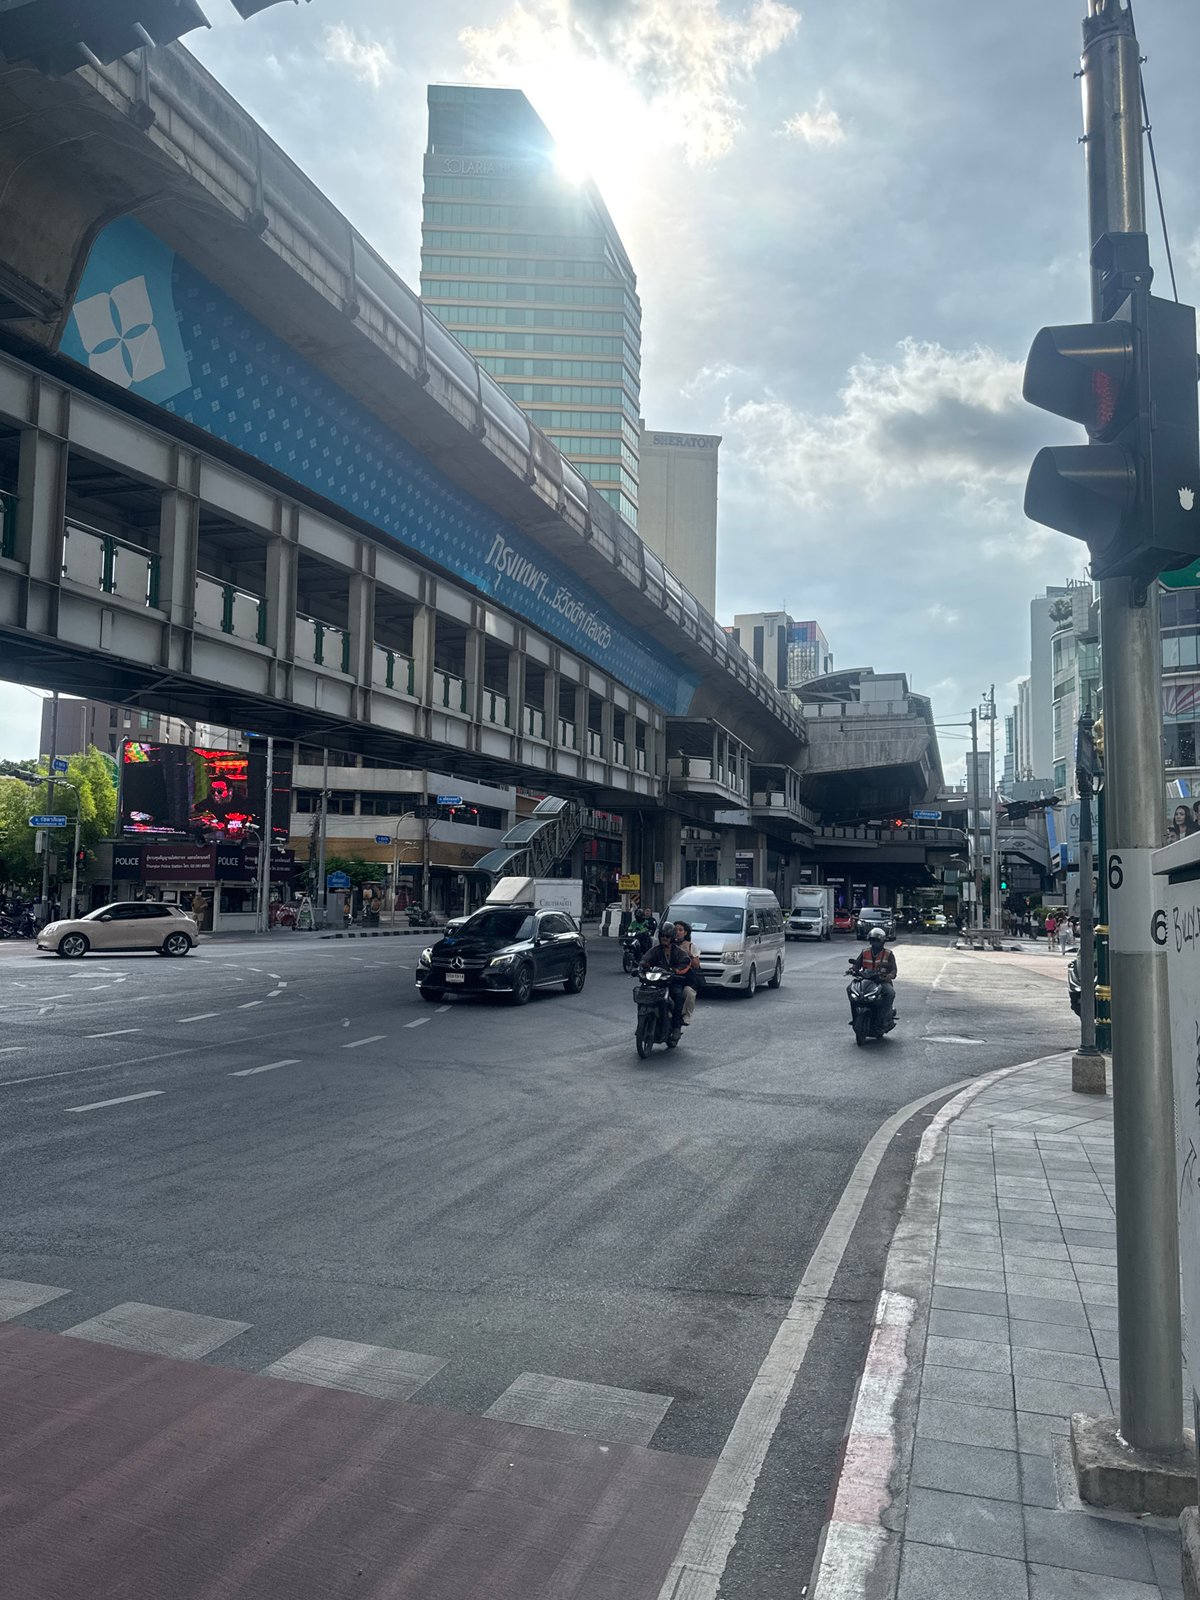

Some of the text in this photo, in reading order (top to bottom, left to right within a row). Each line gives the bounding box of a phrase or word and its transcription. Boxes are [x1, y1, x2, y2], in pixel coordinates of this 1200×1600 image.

[442, 158, 495, 174] SOLARIA
[653, 435, 714, 449] SHERATON
[115, 857, 139, 866] POLICE
[217, 856, 239, 866] POLICE
[1108, 854, 1124, 889] 6
[1150, 909, 1168, 945] 6
